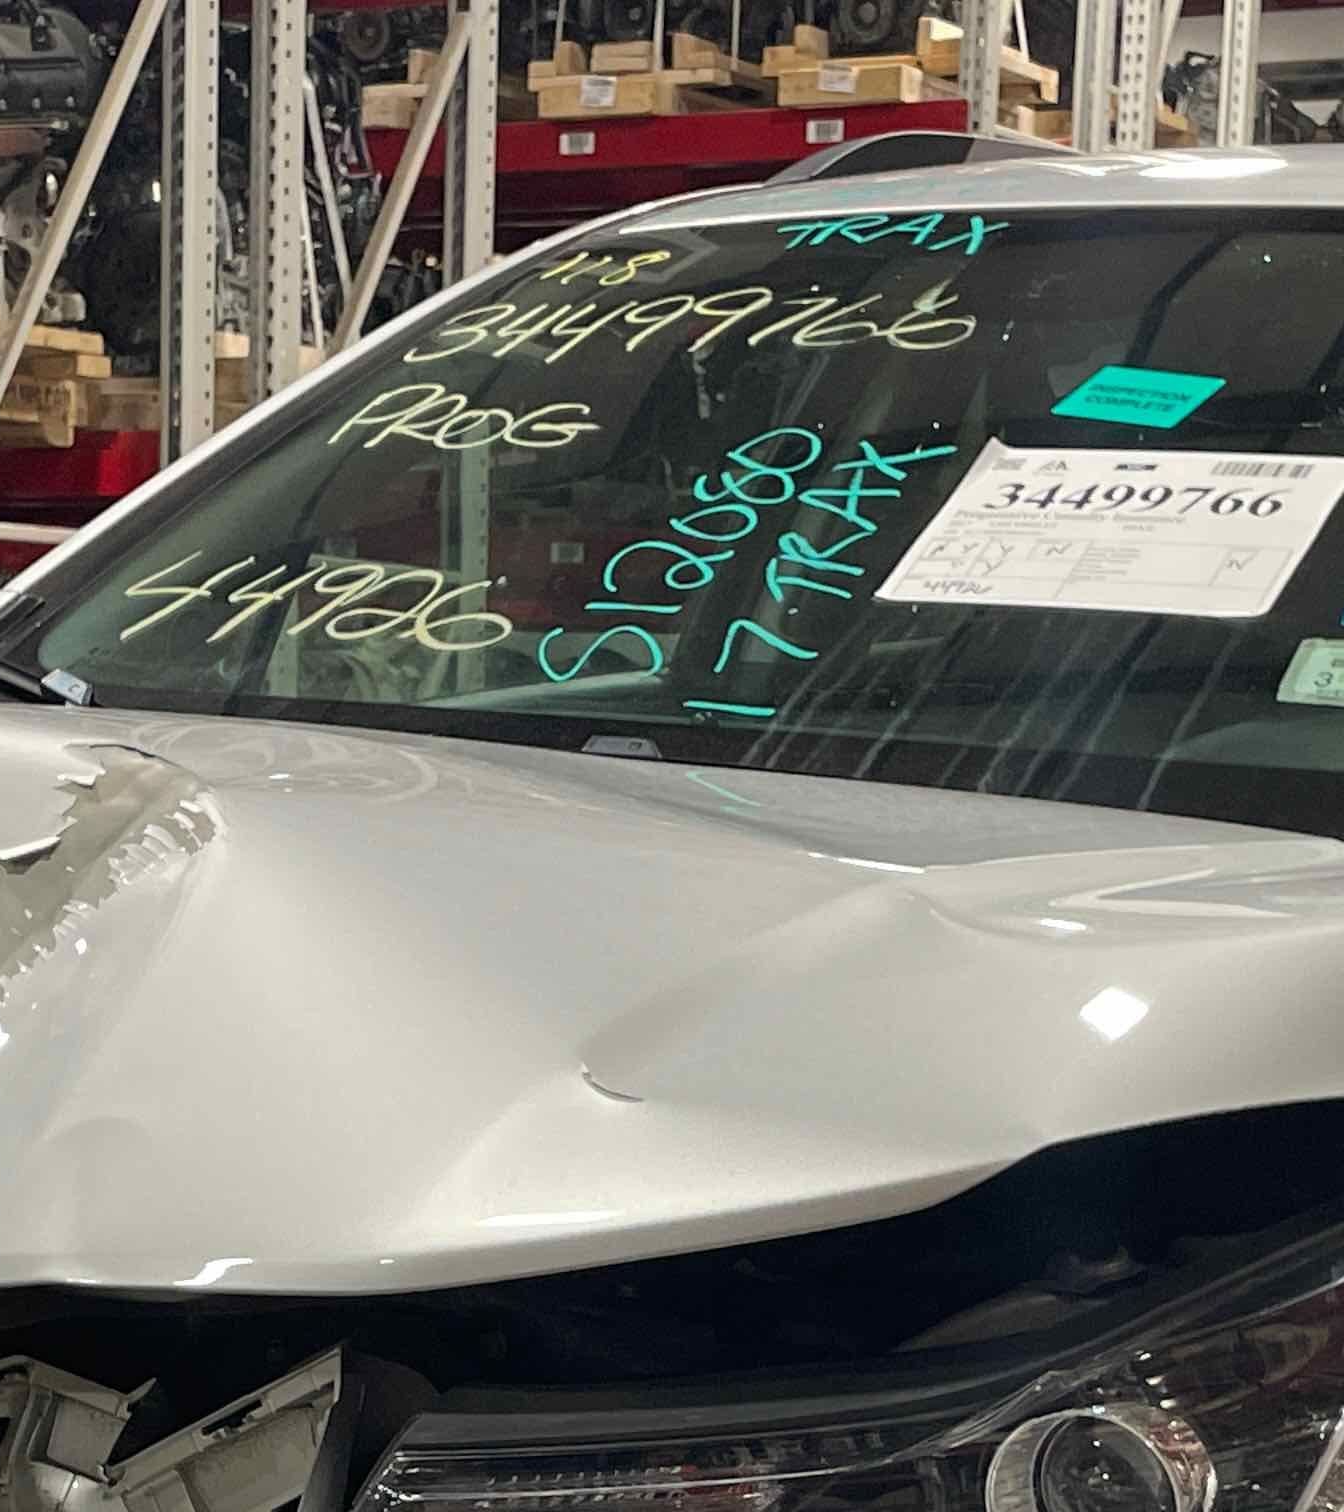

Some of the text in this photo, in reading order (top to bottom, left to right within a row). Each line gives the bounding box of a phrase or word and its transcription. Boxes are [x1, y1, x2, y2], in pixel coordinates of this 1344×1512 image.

[777, 213, 1010, 255] TRAX
[404, 285, 976, 363] 34499766
[328, 384, 601, 449] PROG
[765, 440, 958, 602] TRAX
[981, 483, 1293, 517] 34499766
[120, 551, 514, 651] 44926
[1313, 671, 1334, 688] 3
